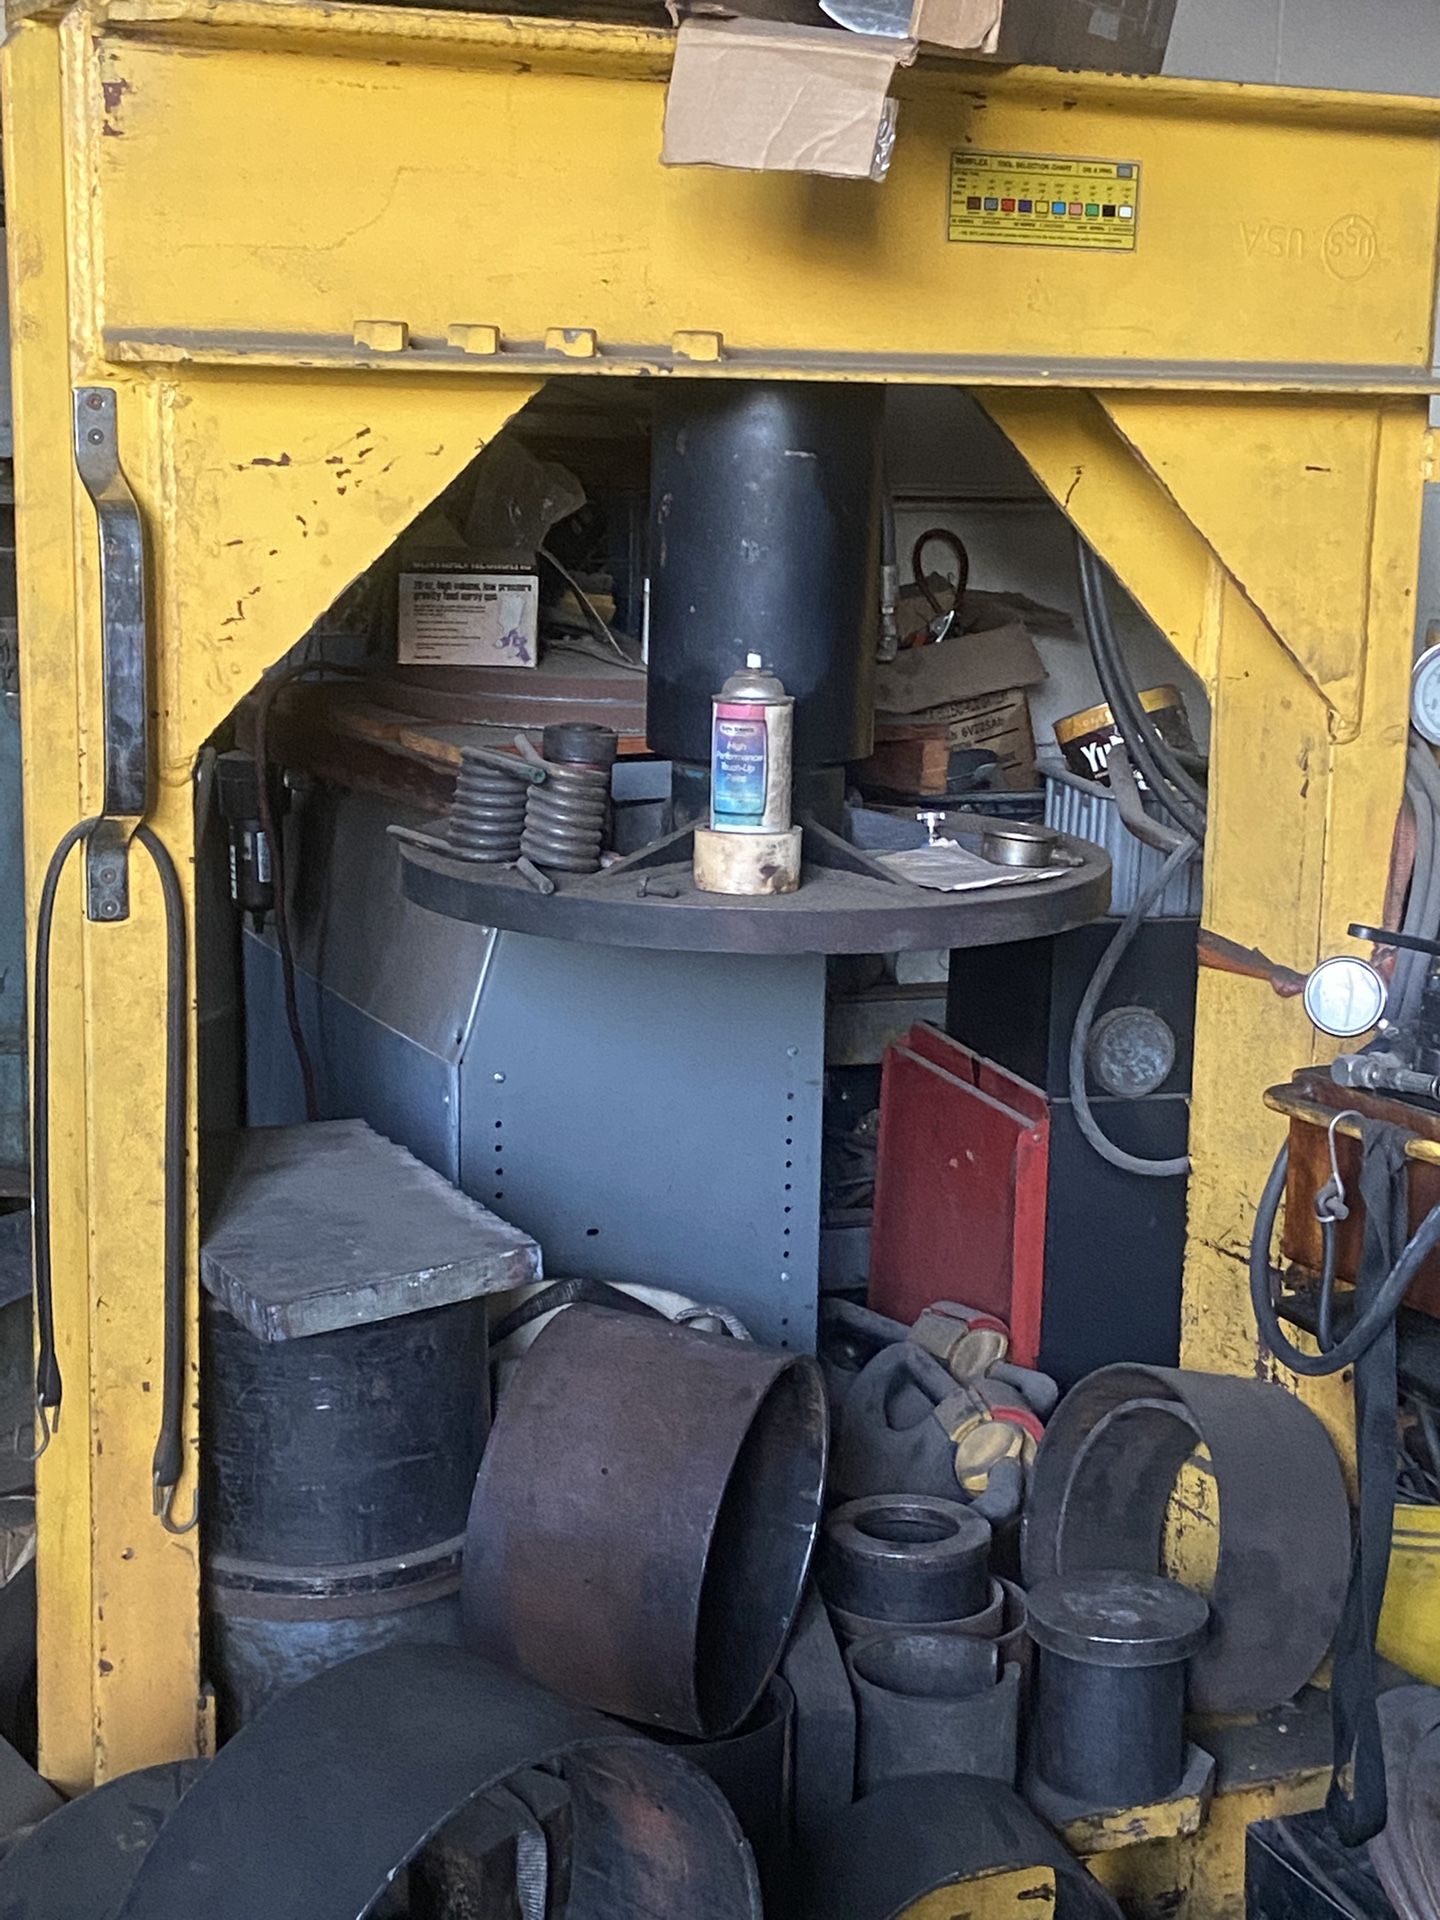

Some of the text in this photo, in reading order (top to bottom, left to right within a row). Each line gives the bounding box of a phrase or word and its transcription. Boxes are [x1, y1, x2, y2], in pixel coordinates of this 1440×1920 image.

[998, 160, 1013, 169] TOOL
[1015, 161, 1050, 171] SELECTION
[1052, 164, 1073, 172] CHART
[1240, 221, 1304, 258] USA
[436, 582, 451, 592] high
[483, 583, 497, 591] low
[499, 584, 532, 592] pressure
[414, 592, 441, 602] gravity
[461, 593, 483, 602] spray
[726, 741, 748, 752] High
[716, 750, 764, 762] Performance
[721, 761, 756, 774] Touch-Up
